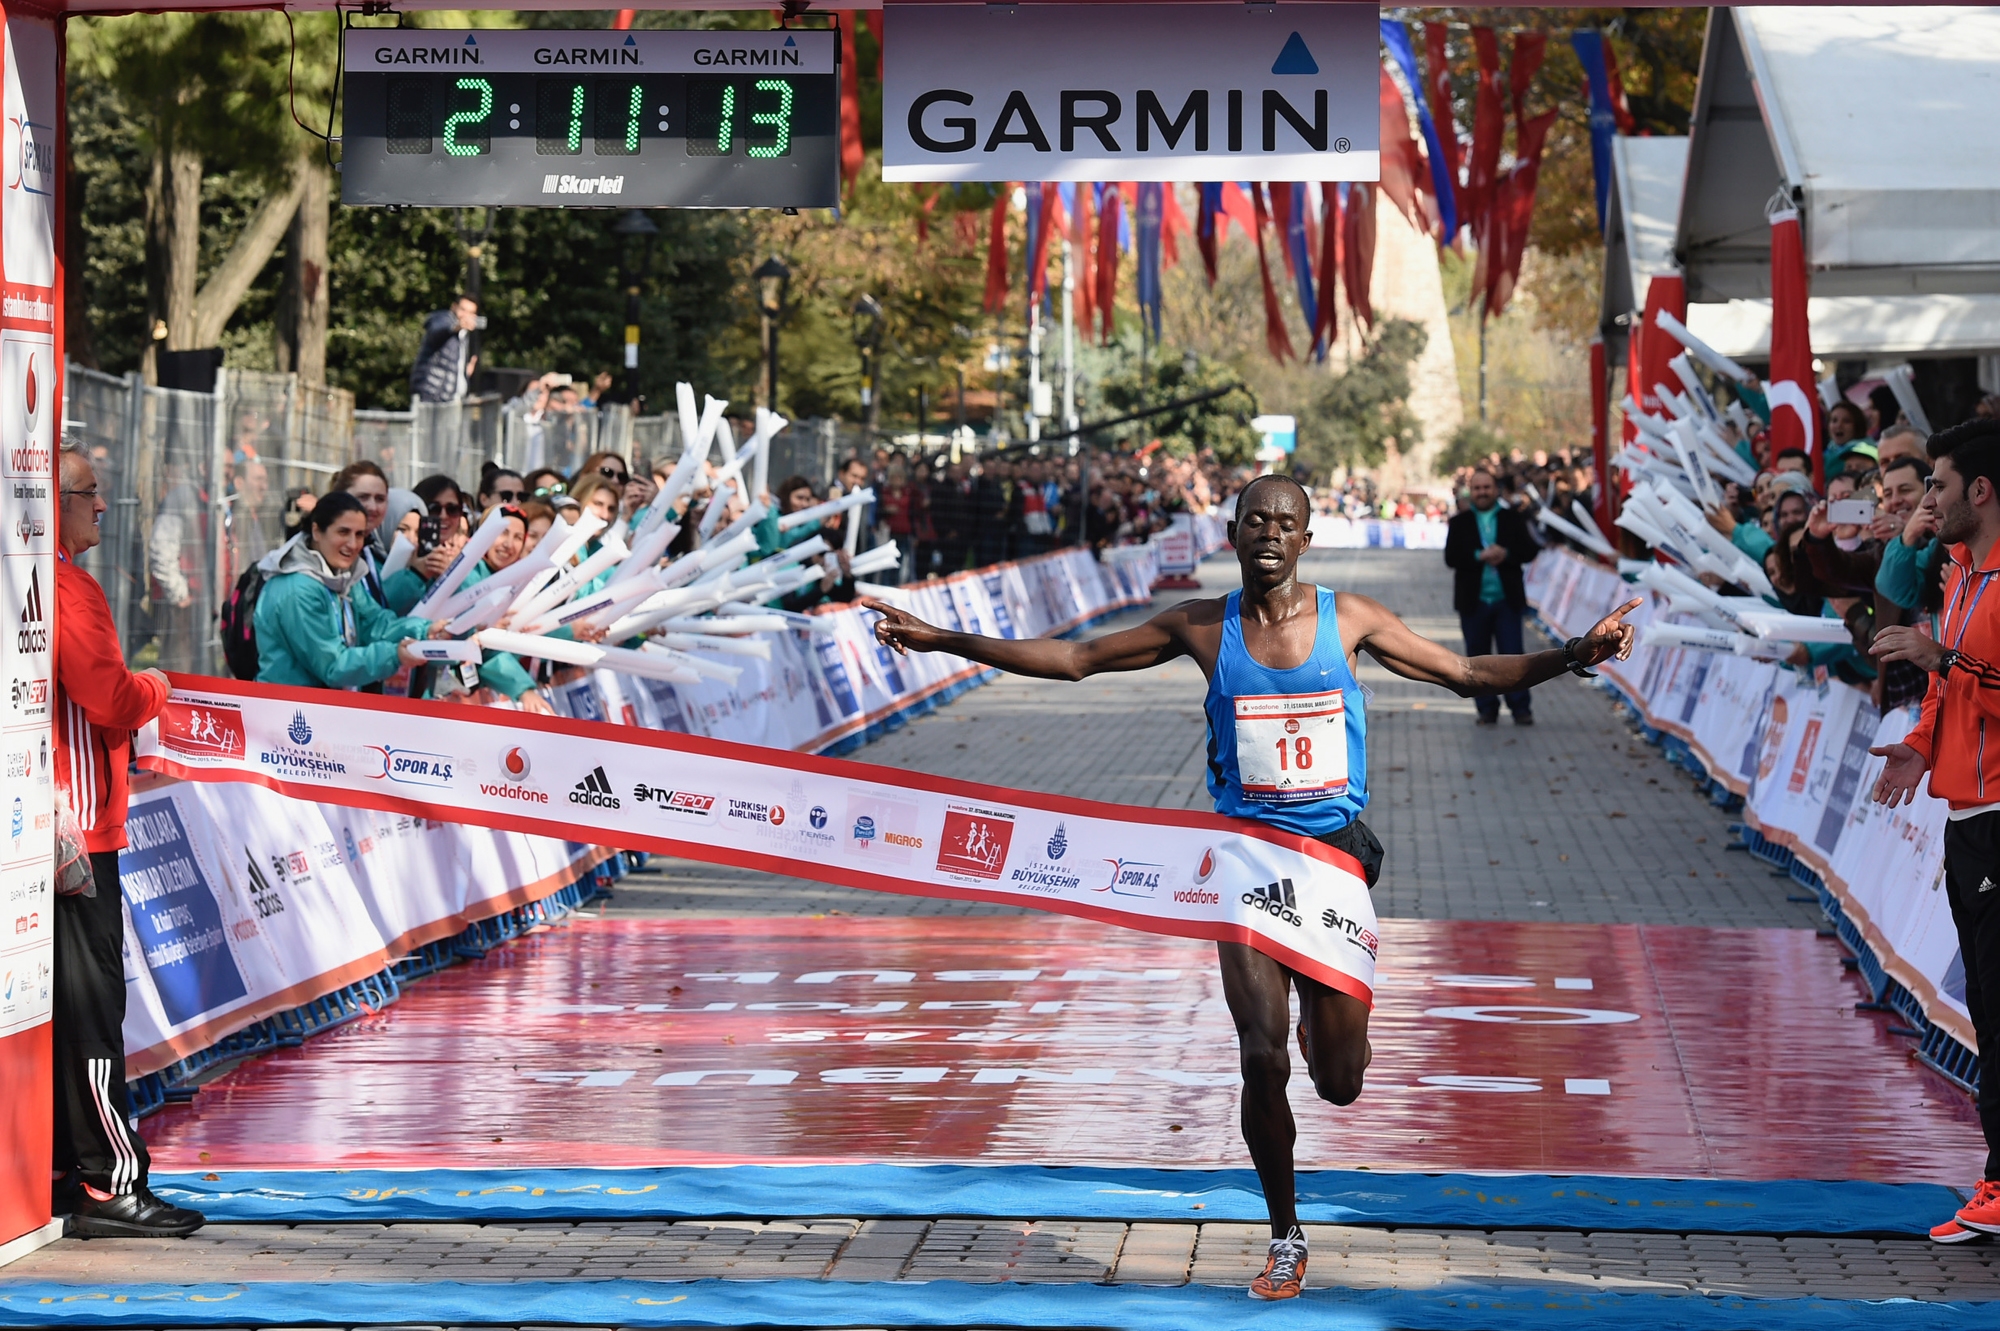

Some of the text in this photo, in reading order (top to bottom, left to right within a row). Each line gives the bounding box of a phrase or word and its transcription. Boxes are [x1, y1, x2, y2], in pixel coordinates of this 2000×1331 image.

[375, 47, 482, 65] GARMIN
[534, 48, 640, 65] GARMIN
[694, 49, 800, 66] GARMIN
[907, 89, 1329, 153] GARMIN
[559, 174, 624, 195] Skorled
[11, 439, 49, 473] vodafone
[18, 621, 47, 654] adidas
[275, 744, 328, 759] İSTANBUL
[1276, 736, 1313, 771] 18
[260, 750, 347, 776] BÜYÜKŞEHİR
[393, 758, 454, 782] SPOR A.Ş.
[276, 768, 332, 780] BELEDİYESİ
[480, 783, 548, 804] vodafone
[569, 789, 621, 810] adidas
[728, 799, 768, 813] TURKISH
[728, 808, 768, 822] AIRLINES
[799, 829, 836, 842] TEMSA
[1028, 861, 1072, 874] İSTANBUL
[1010, 866, 1080, 889] BÜYÜKŞEHİR
[1118, 870, 1143, 885] SPOR
[1173, 888, 1219, 905] vodafone
[1241, 892, 1303, 927] adidas
